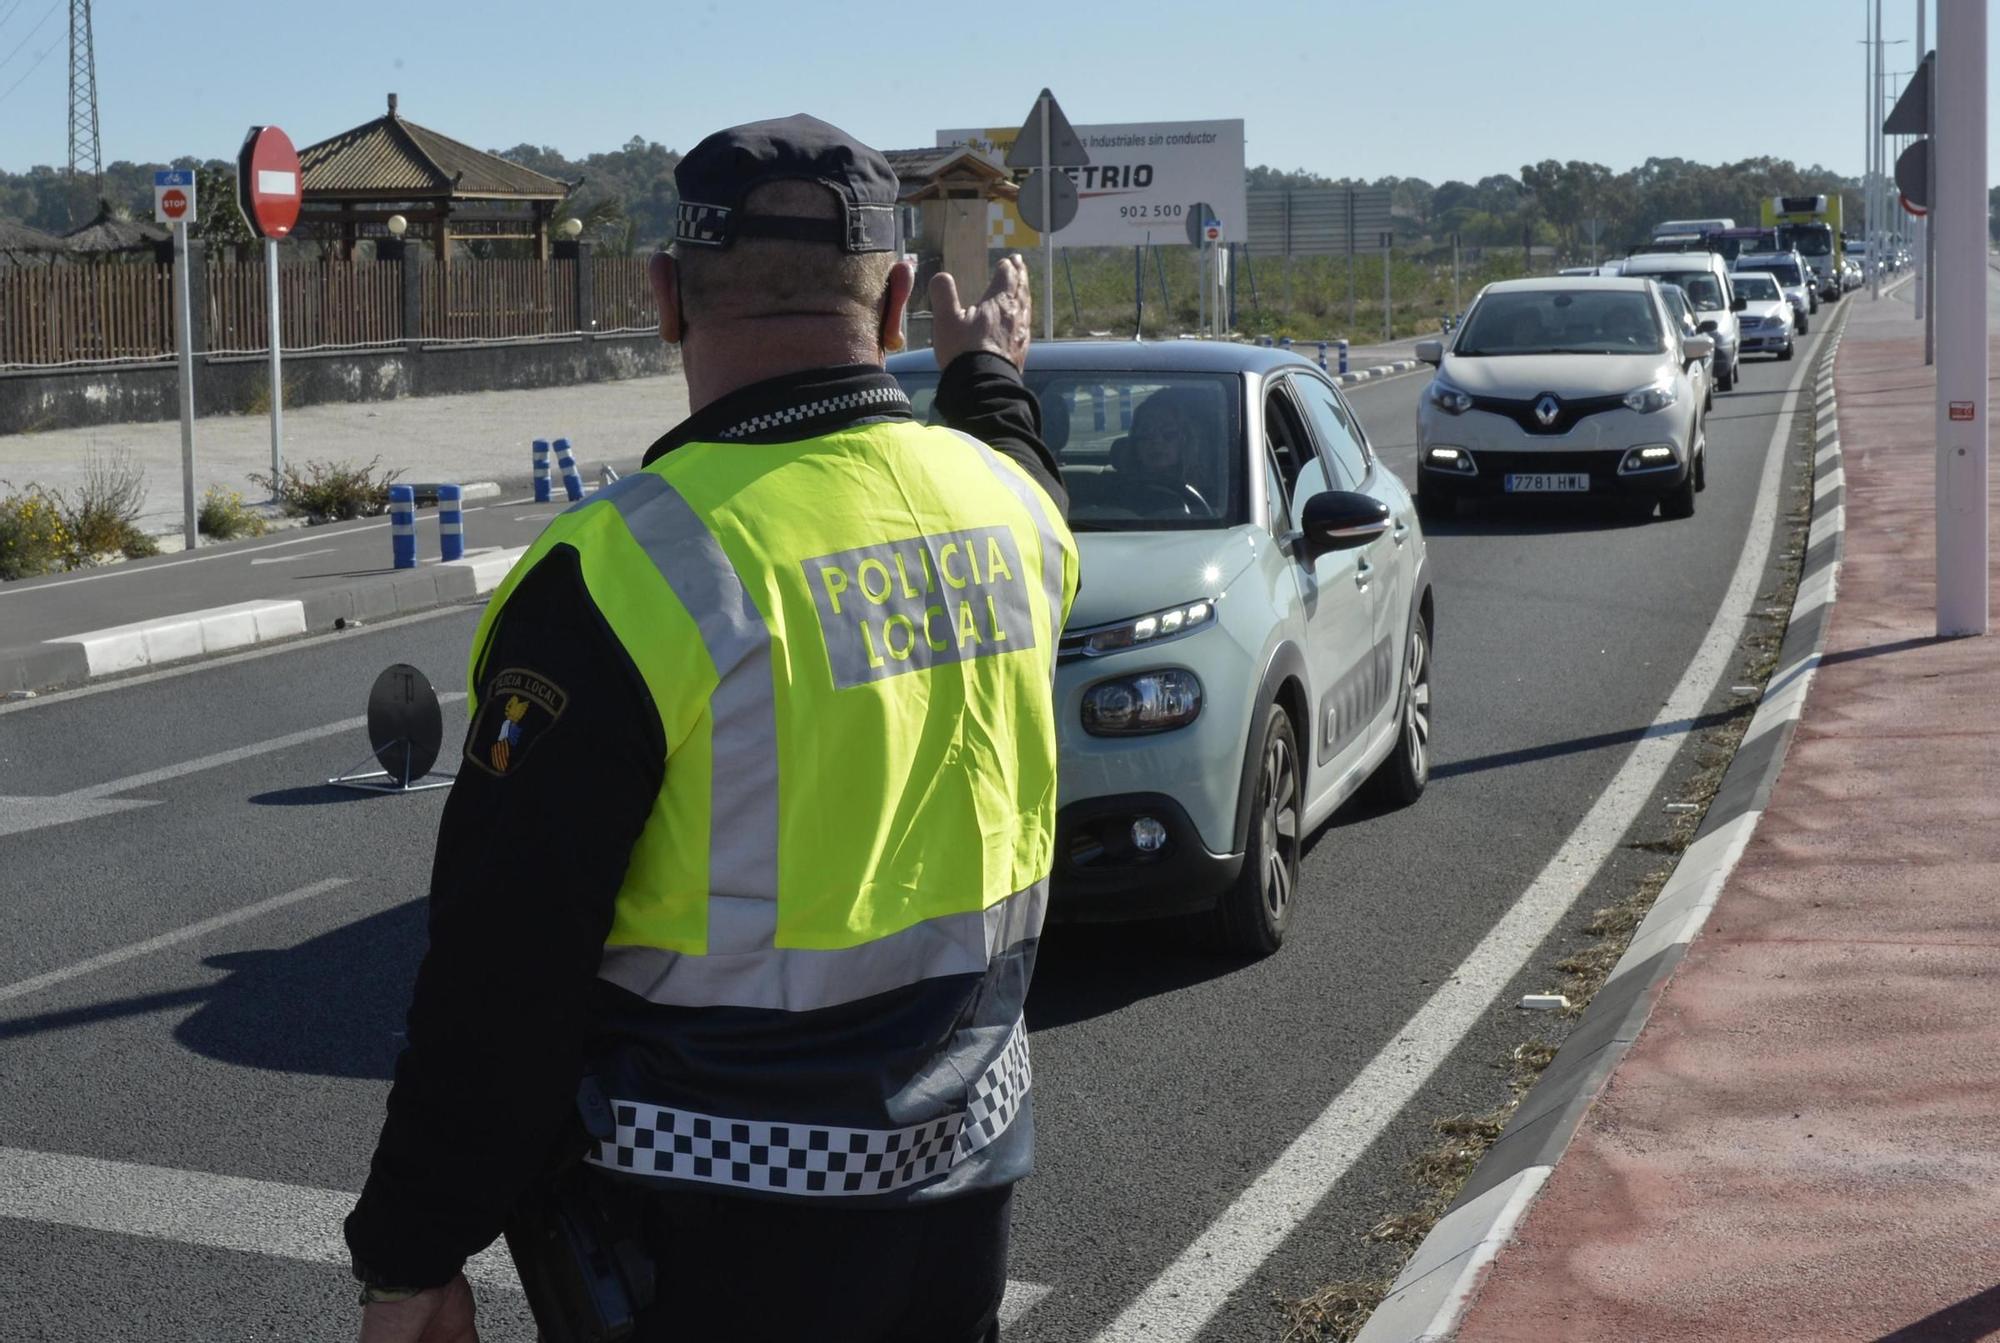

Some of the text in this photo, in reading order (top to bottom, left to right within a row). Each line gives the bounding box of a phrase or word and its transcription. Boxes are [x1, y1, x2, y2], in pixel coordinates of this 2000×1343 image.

[1090, 134, 1146, 148] Industriales
[1148, 133, 1163, 146] sin
[1166, 132, 1217, 145] conductor
[164, 199, 185, 208] STOP
[1119, 204, 1182, 219] 902 500
[1514, 475, 1585, 490] 7781 HWL
[820, 537, 1012, 614] POLICIA
[860, 595, 1007, 669] LOCAL
[524, 678, 557, 706] LOCAL
